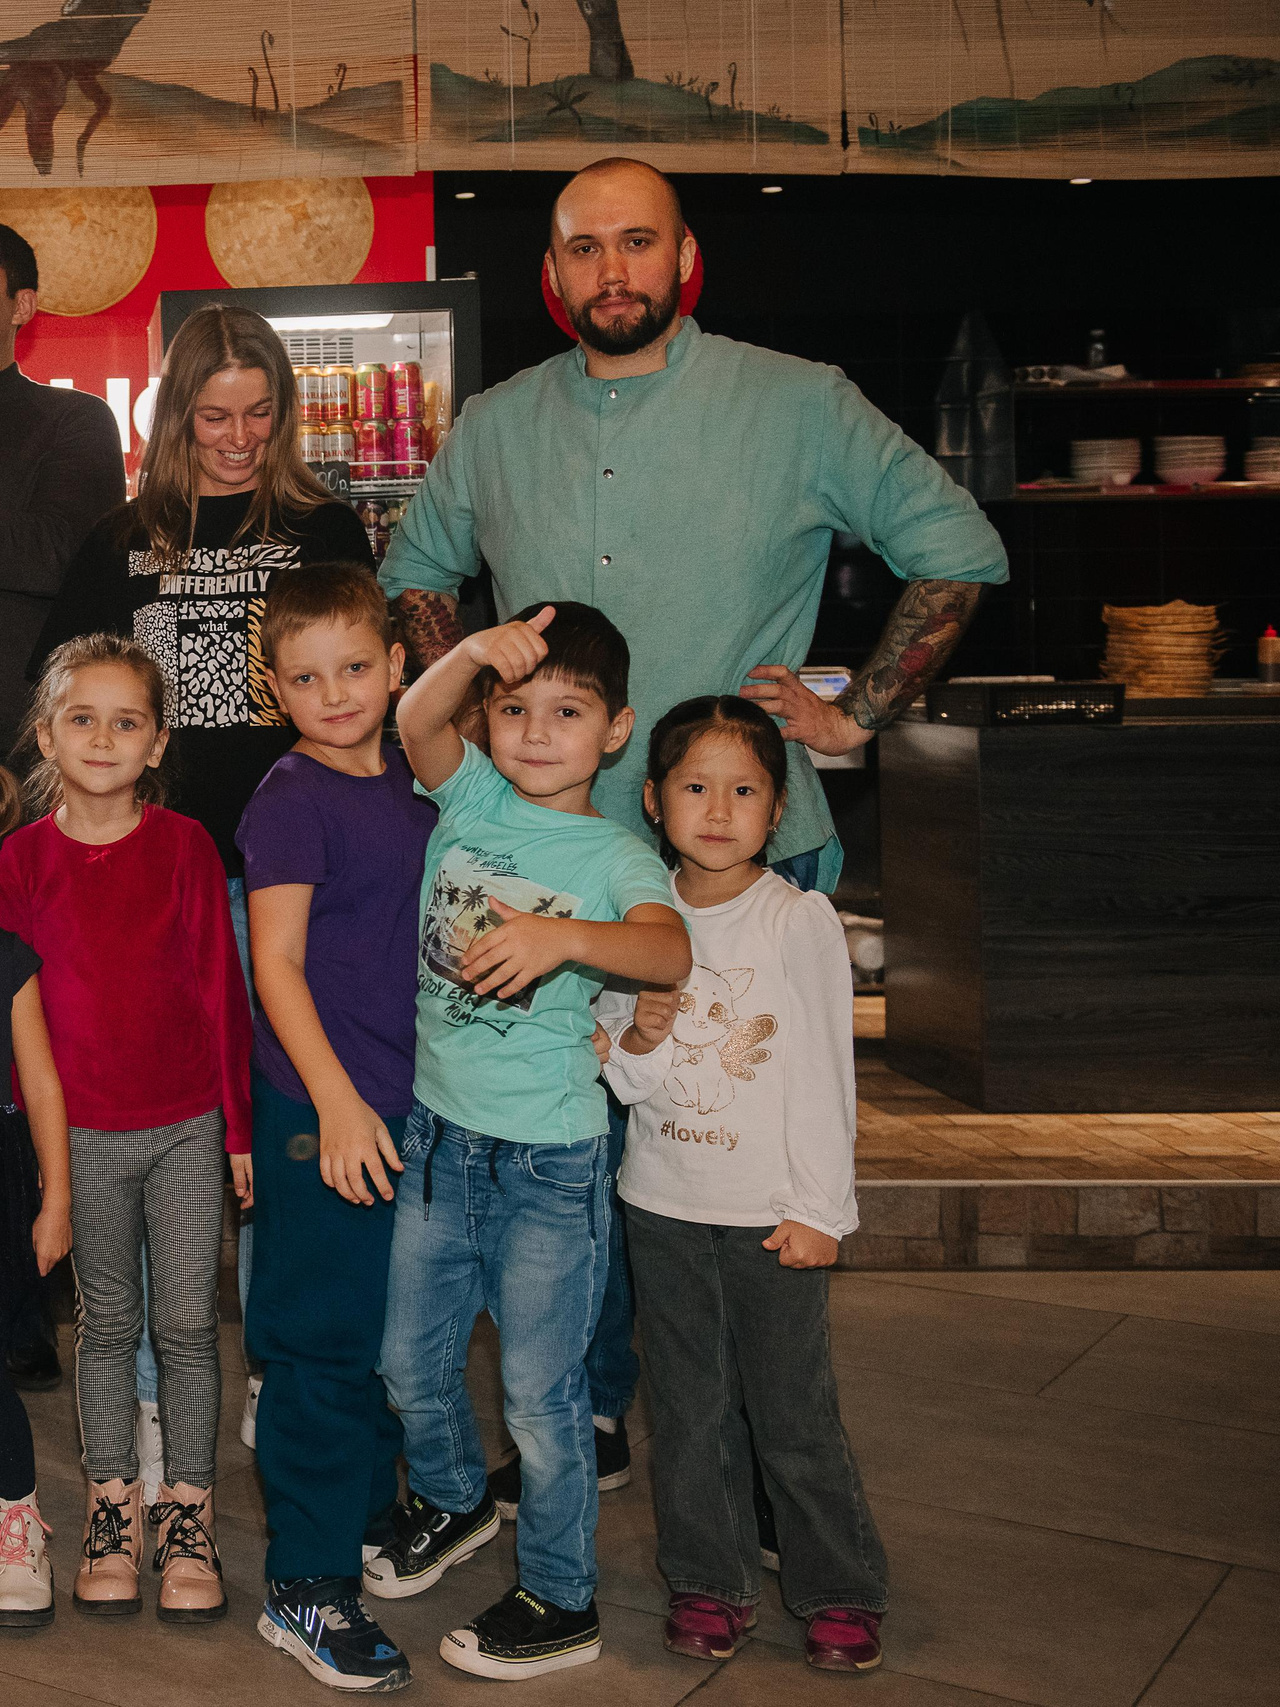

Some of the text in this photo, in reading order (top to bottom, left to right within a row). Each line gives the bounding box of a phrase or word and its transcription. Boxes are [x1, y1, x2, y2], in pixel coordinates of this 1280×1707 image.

[159, 571, 271, 595] DIFFERENTLY
[198, 621, 229, 632] what
[479, 860, 518, 872] ANGELES
[660, 1119, 741, 1152] #lovely
